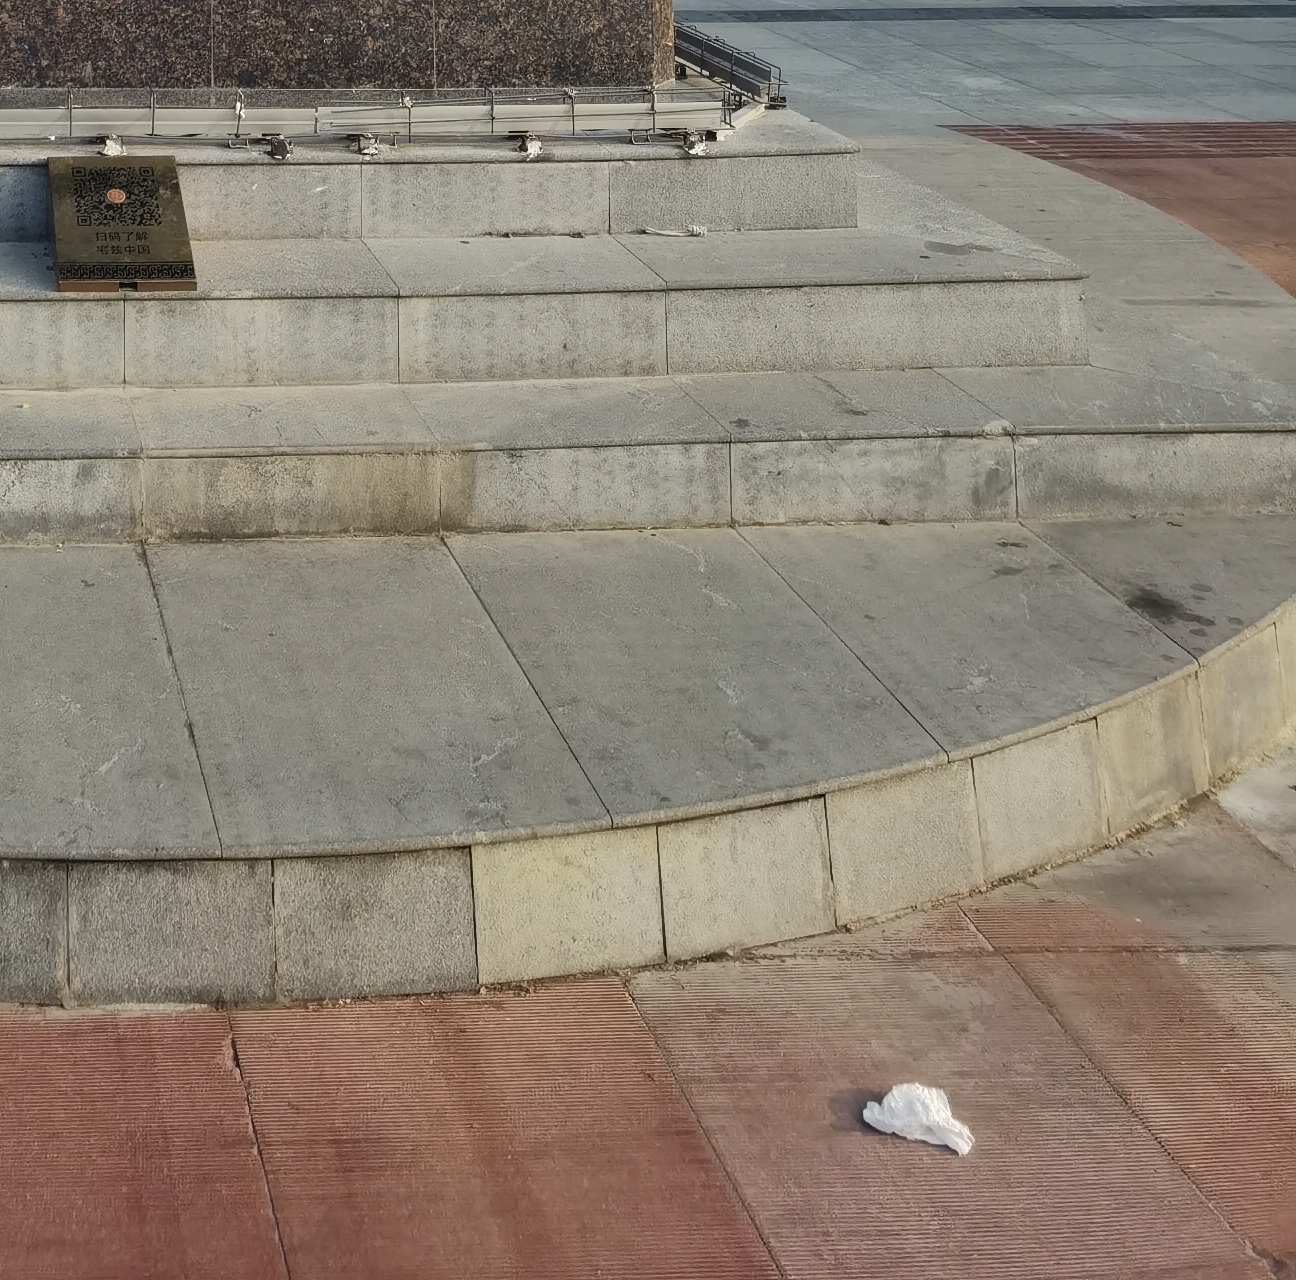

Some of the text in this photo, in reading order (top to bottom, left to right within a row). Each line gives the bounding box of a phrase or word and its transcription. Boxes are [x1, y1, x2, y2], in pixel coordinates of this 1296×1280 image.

[95, 231, 148, 242] 扫码了解
[96, 244, 151, 255] 宅兹中国
